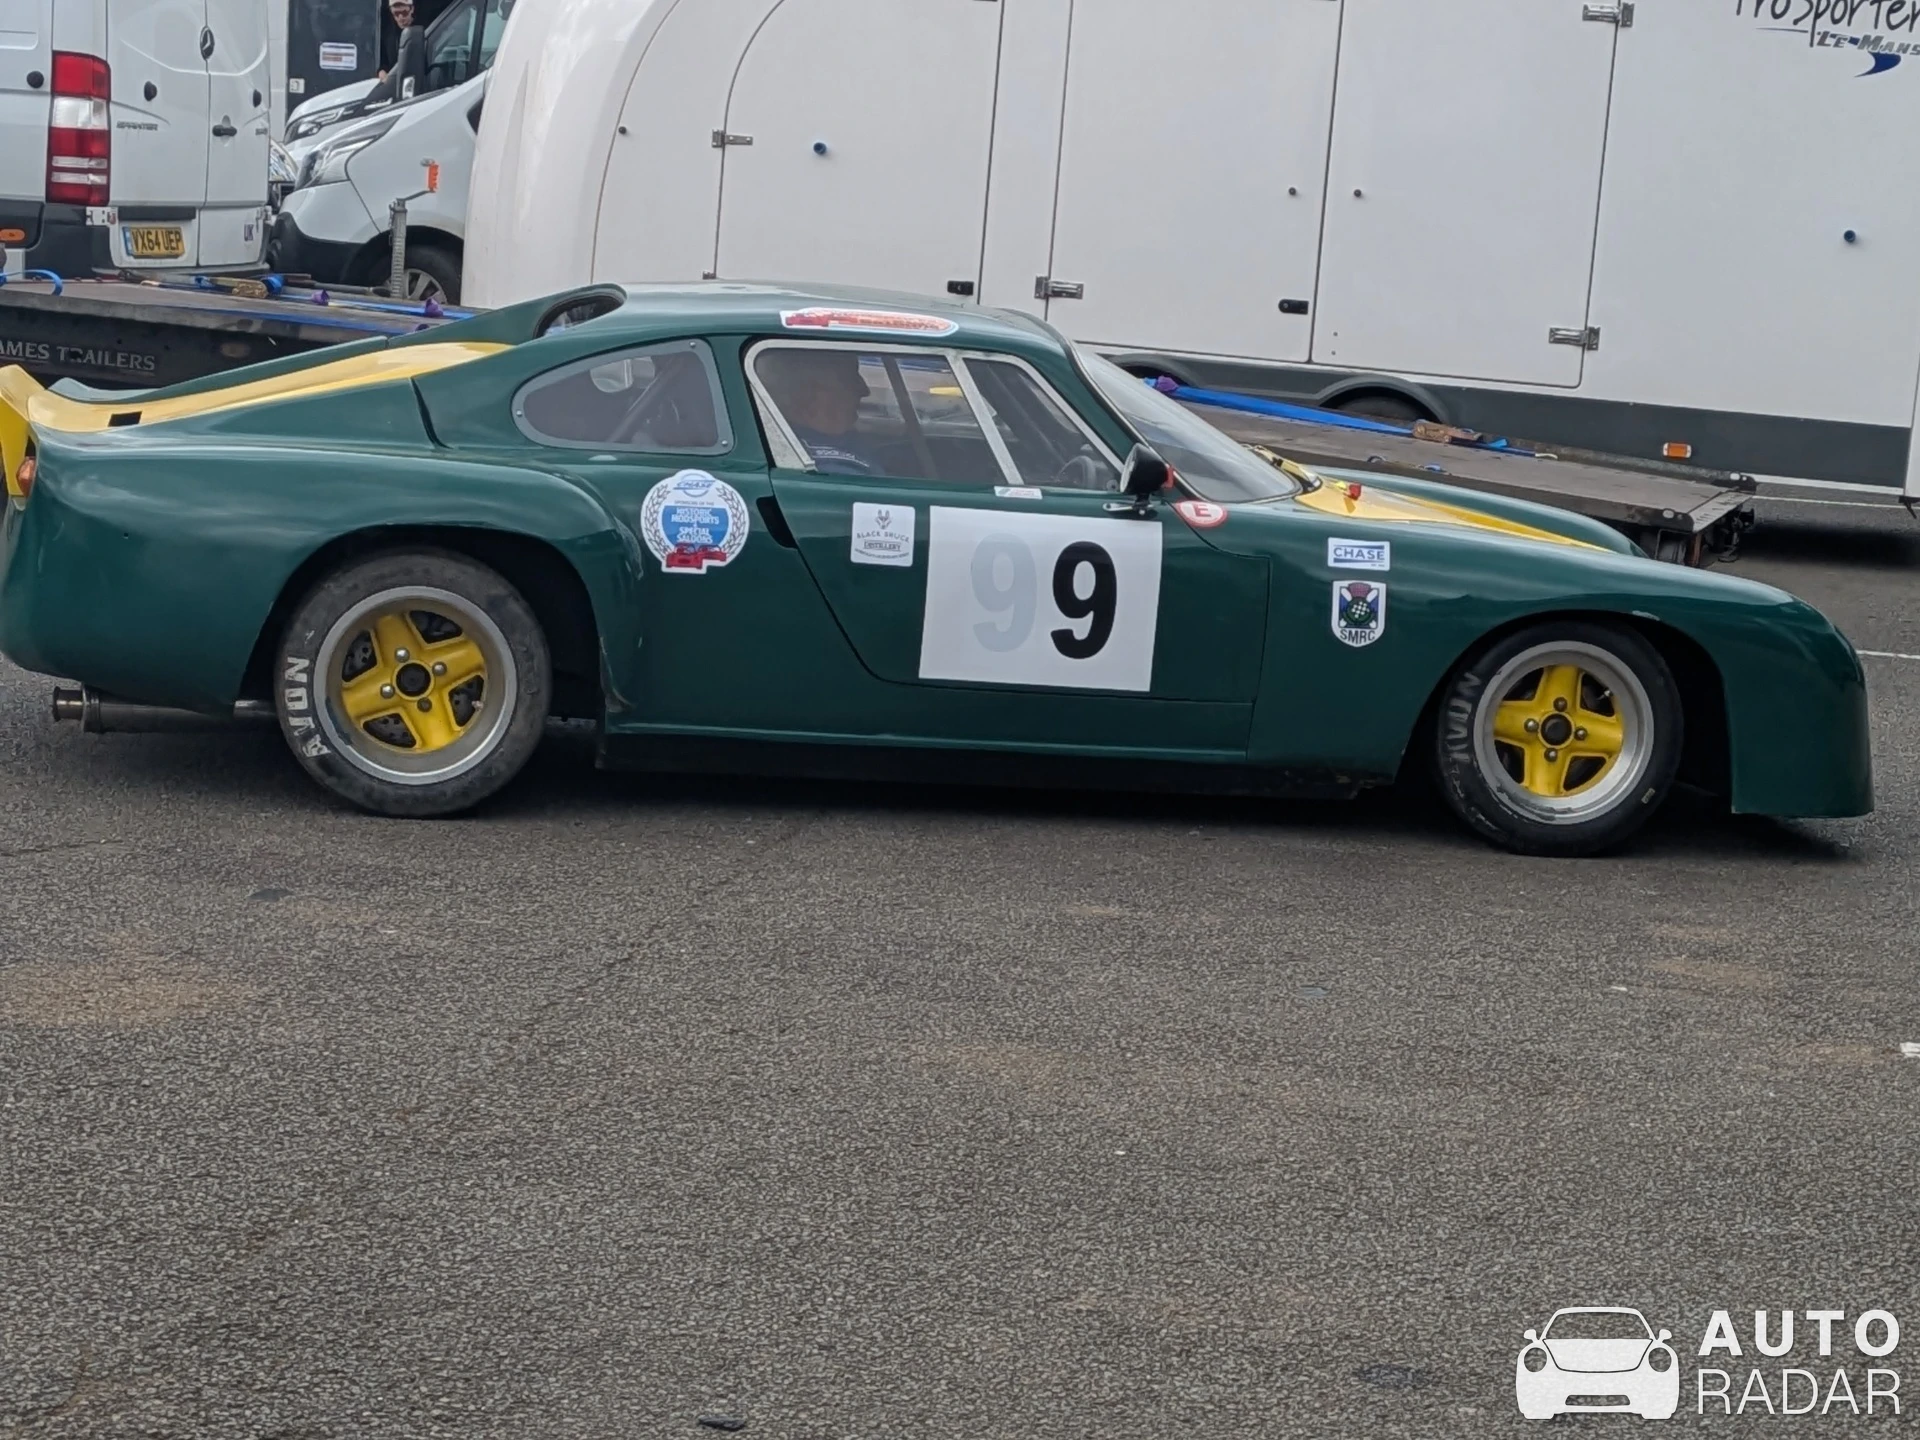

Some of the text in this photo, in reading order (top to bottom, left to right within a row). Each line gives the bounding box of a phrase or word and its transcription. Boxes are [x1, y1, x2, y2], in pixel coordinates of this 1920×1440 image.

[131, 228, 182, 252] VX64 UEP
[243, 224, 254, 242] UK
[1192, 502, 1212, 518] E
[857, 530, 881, 540] BLACK
[1333, 546, 1386, 561] CHASE
[1339, 629, 1376, 645] SMRC
